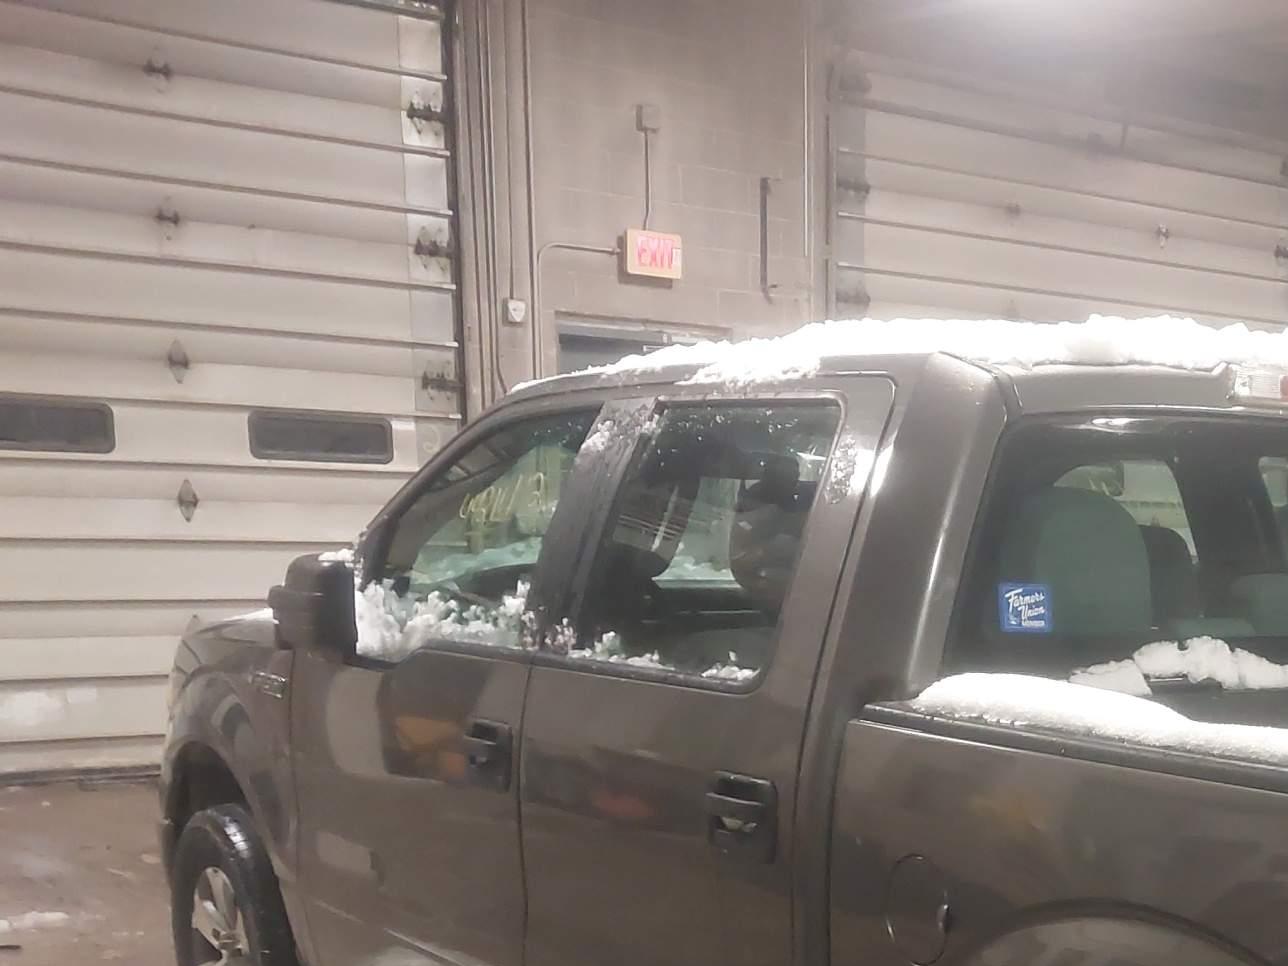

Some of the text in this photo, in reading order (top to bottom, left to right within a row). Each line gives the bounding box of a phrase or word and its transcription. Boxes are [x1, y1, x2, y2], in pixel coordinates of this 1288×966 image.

[637, 236, 672, 269] EXIT
[1005, 588, 1045, 613] Farmers
[1018, 605, 1045, 621] Union
